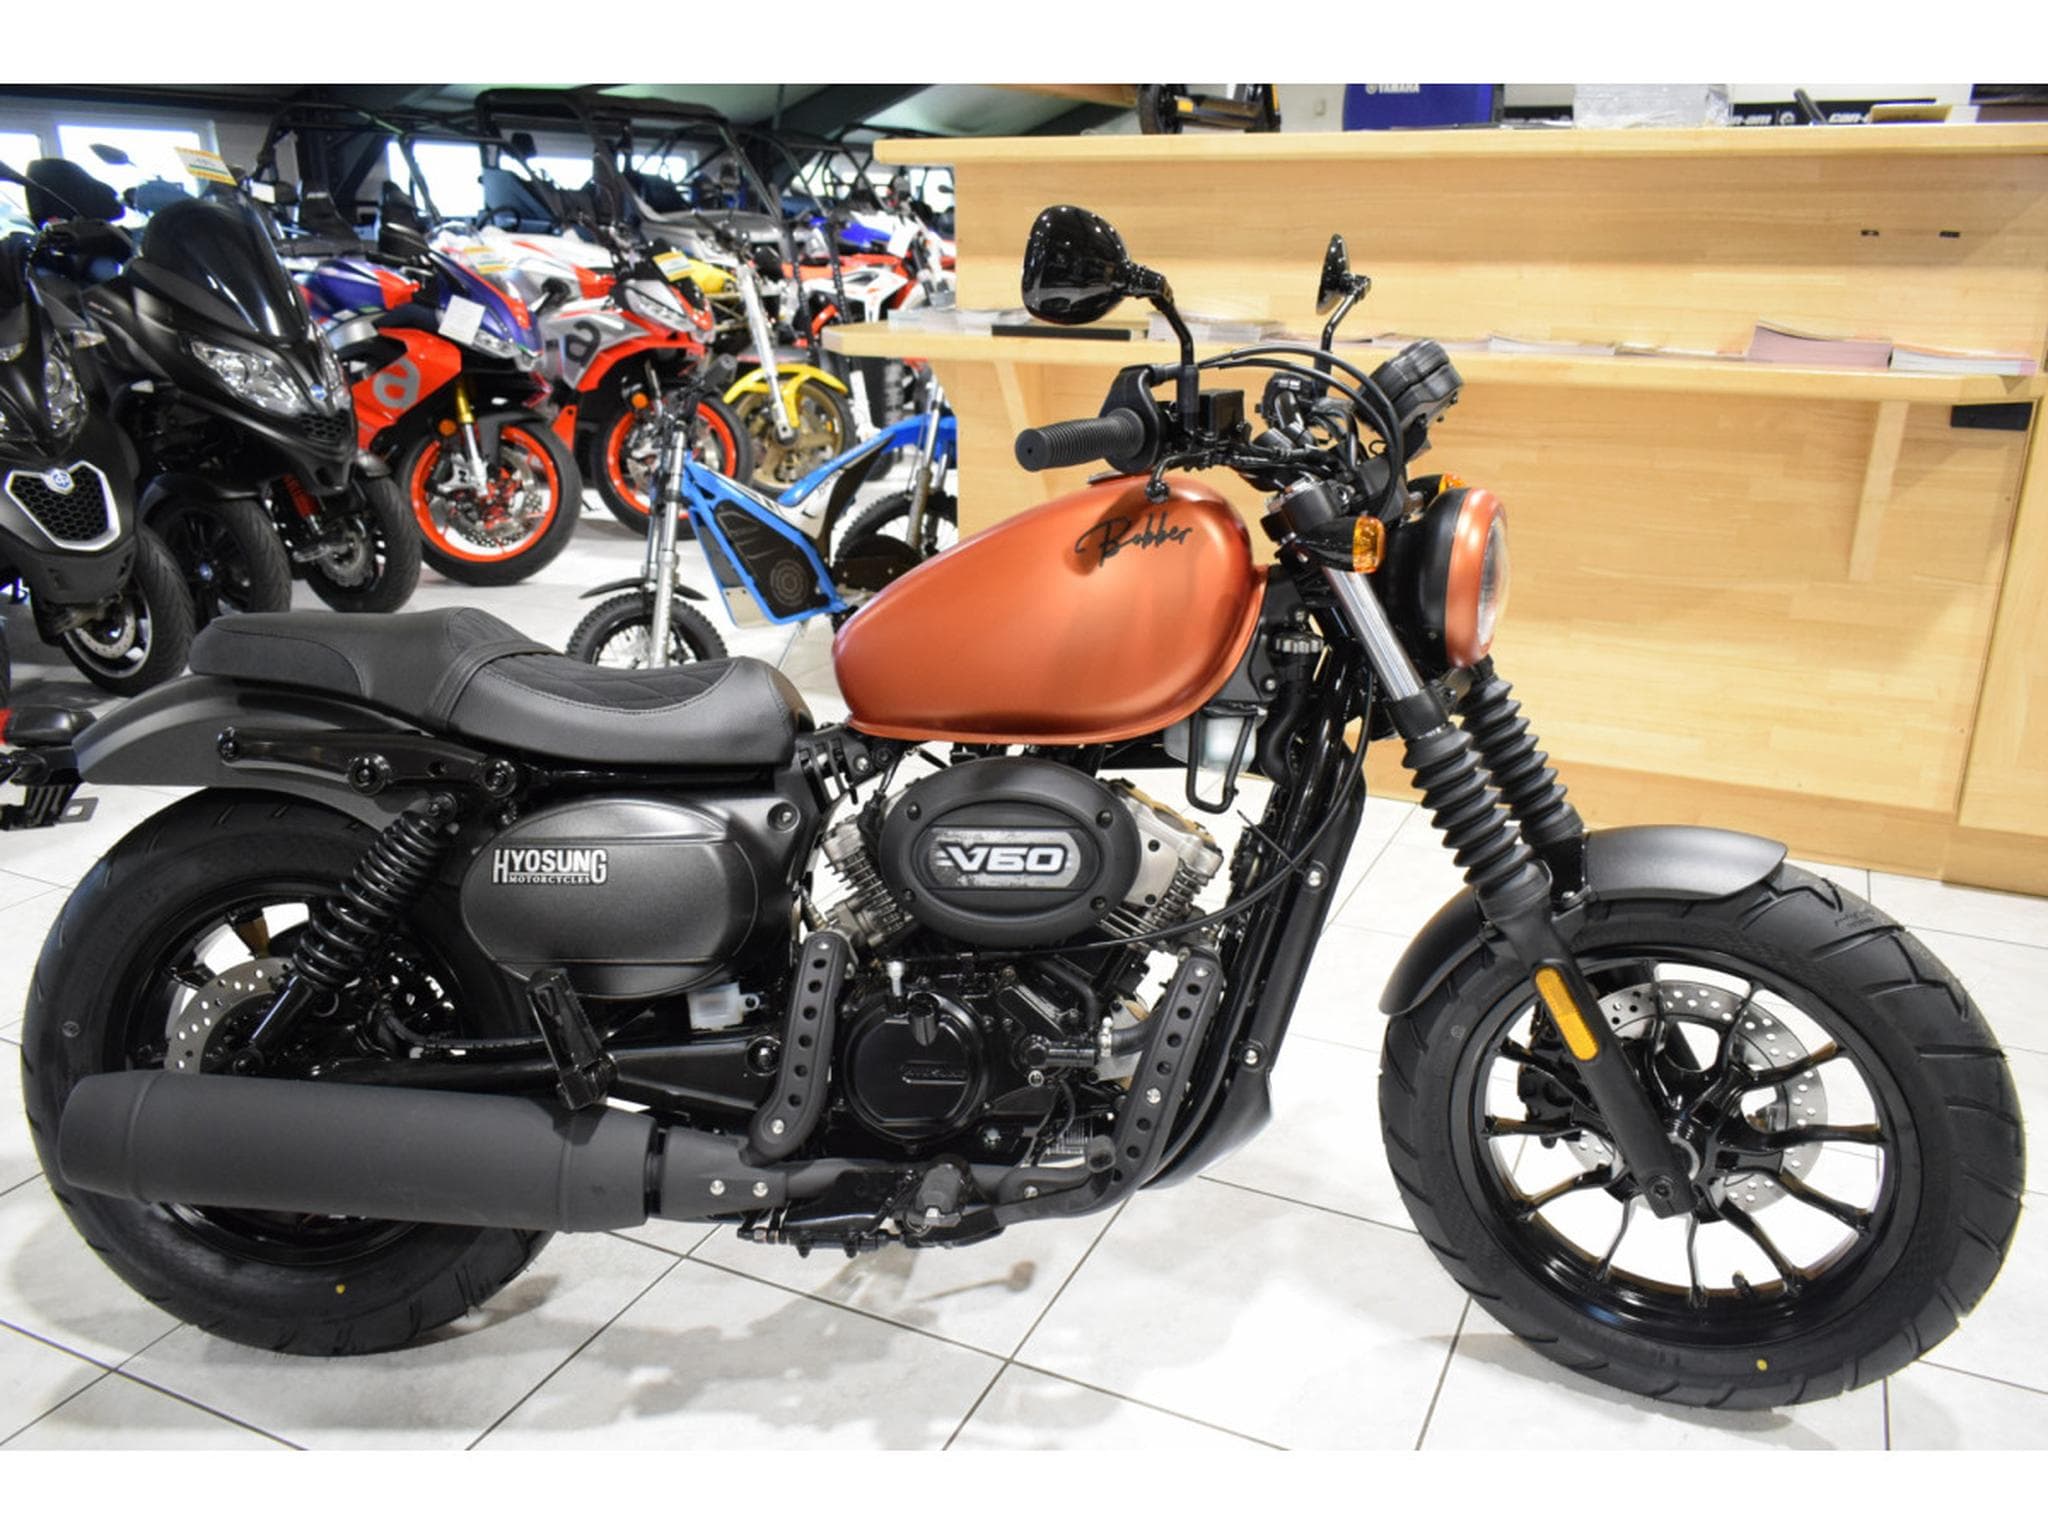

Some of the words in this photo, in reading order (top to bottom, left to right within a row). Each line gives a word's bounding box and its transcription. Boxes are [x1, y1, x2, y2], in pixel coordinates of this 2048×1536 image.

[1075, 511, 1193, 568] Bobber
[492, 849, 607, 884] HYOSUNG
[943, 844, 1066, 873] V60
[509, 875, 590, 884] MOTORCYCLES
